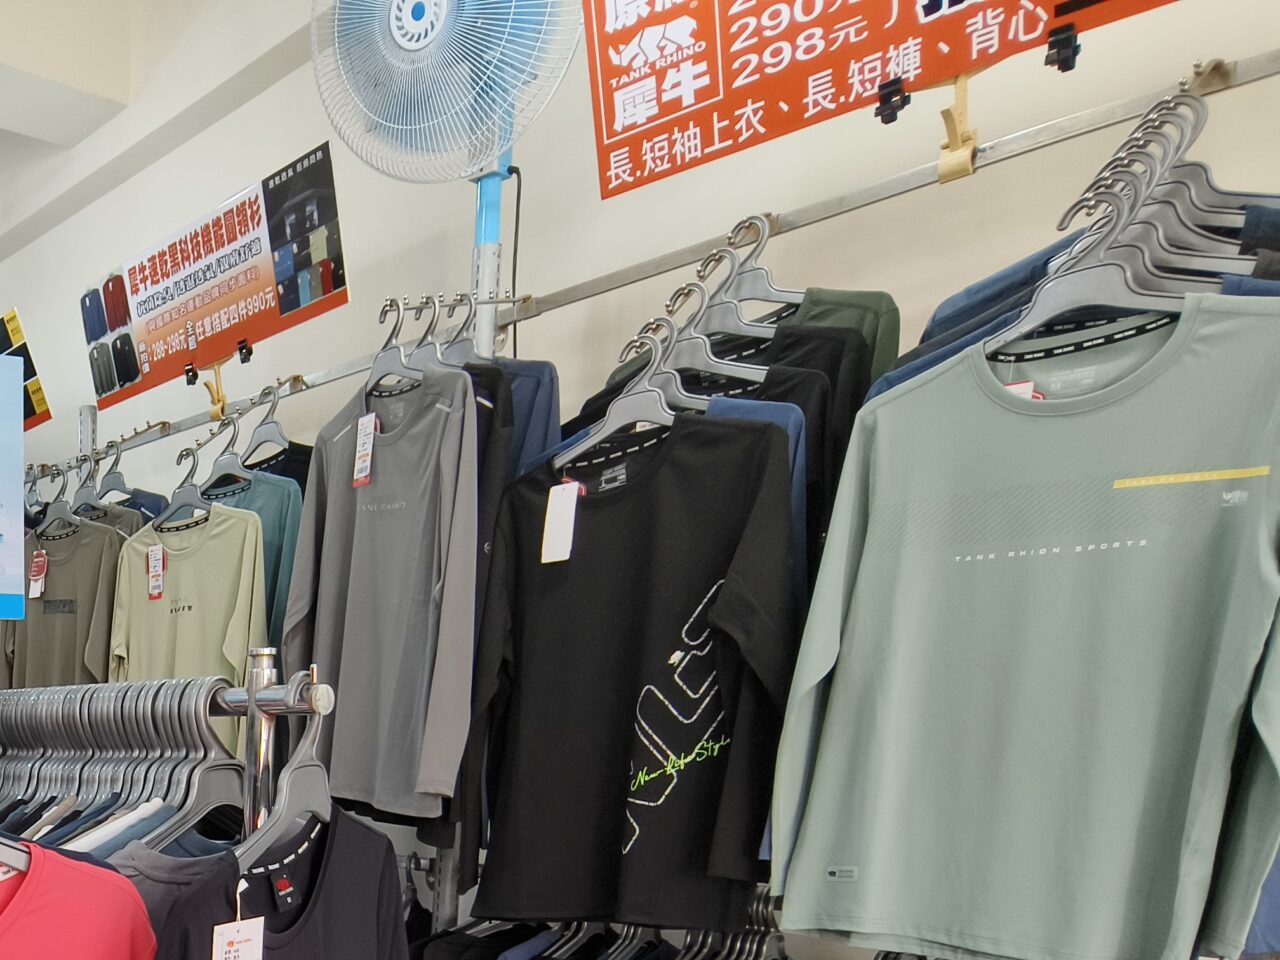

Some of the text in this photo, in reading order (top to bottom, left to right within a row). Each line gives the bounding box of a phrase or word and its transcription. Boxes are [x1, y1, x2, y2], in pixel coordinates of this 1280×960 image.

[609, 41, 707, 88] TANK RHINO
[731, 15, 869, 90] 298元
[612, 59, 711, 132] 犀牛
[955, 553, 996, 562] TANK
[1074, 539, 1148, 552] SPORTS
